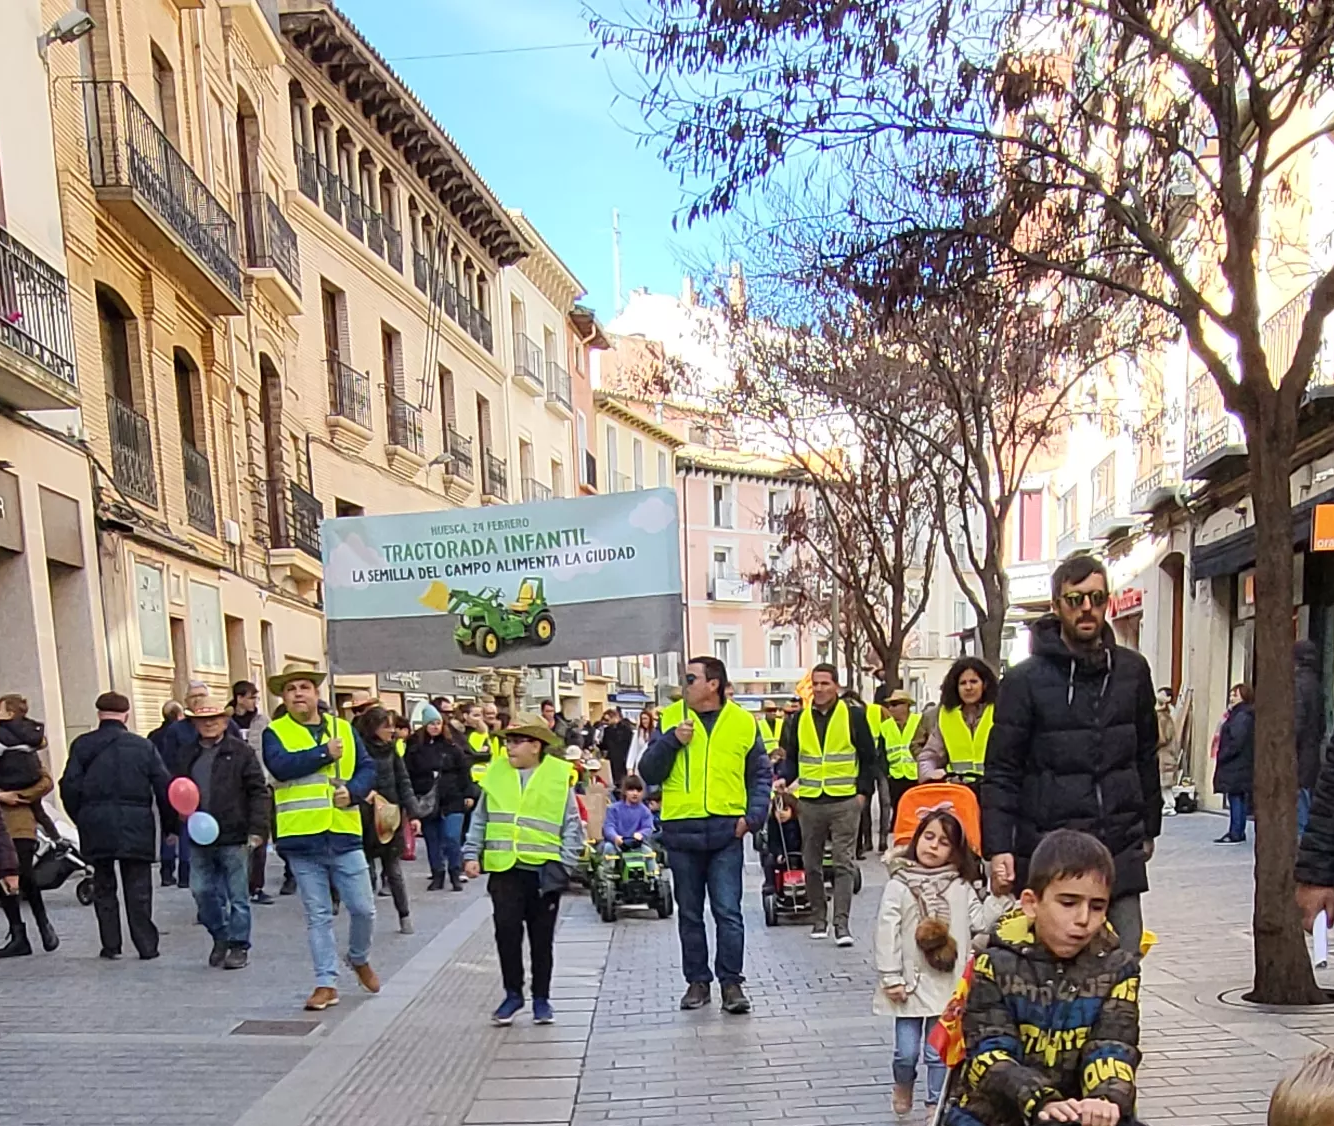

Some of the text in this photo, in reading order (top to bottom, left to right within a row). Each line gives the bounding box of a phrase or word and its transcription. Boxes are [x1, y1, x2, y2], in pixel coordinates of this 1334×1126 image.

[487, 517, 530, 531] FEBRERO
[382, 528, 591, 563] TRACTORADA INFANTIL
[352, 546, 636, 583] LA SEMILLA DEL CAMPO ALIMENTA LA CIUDAD
